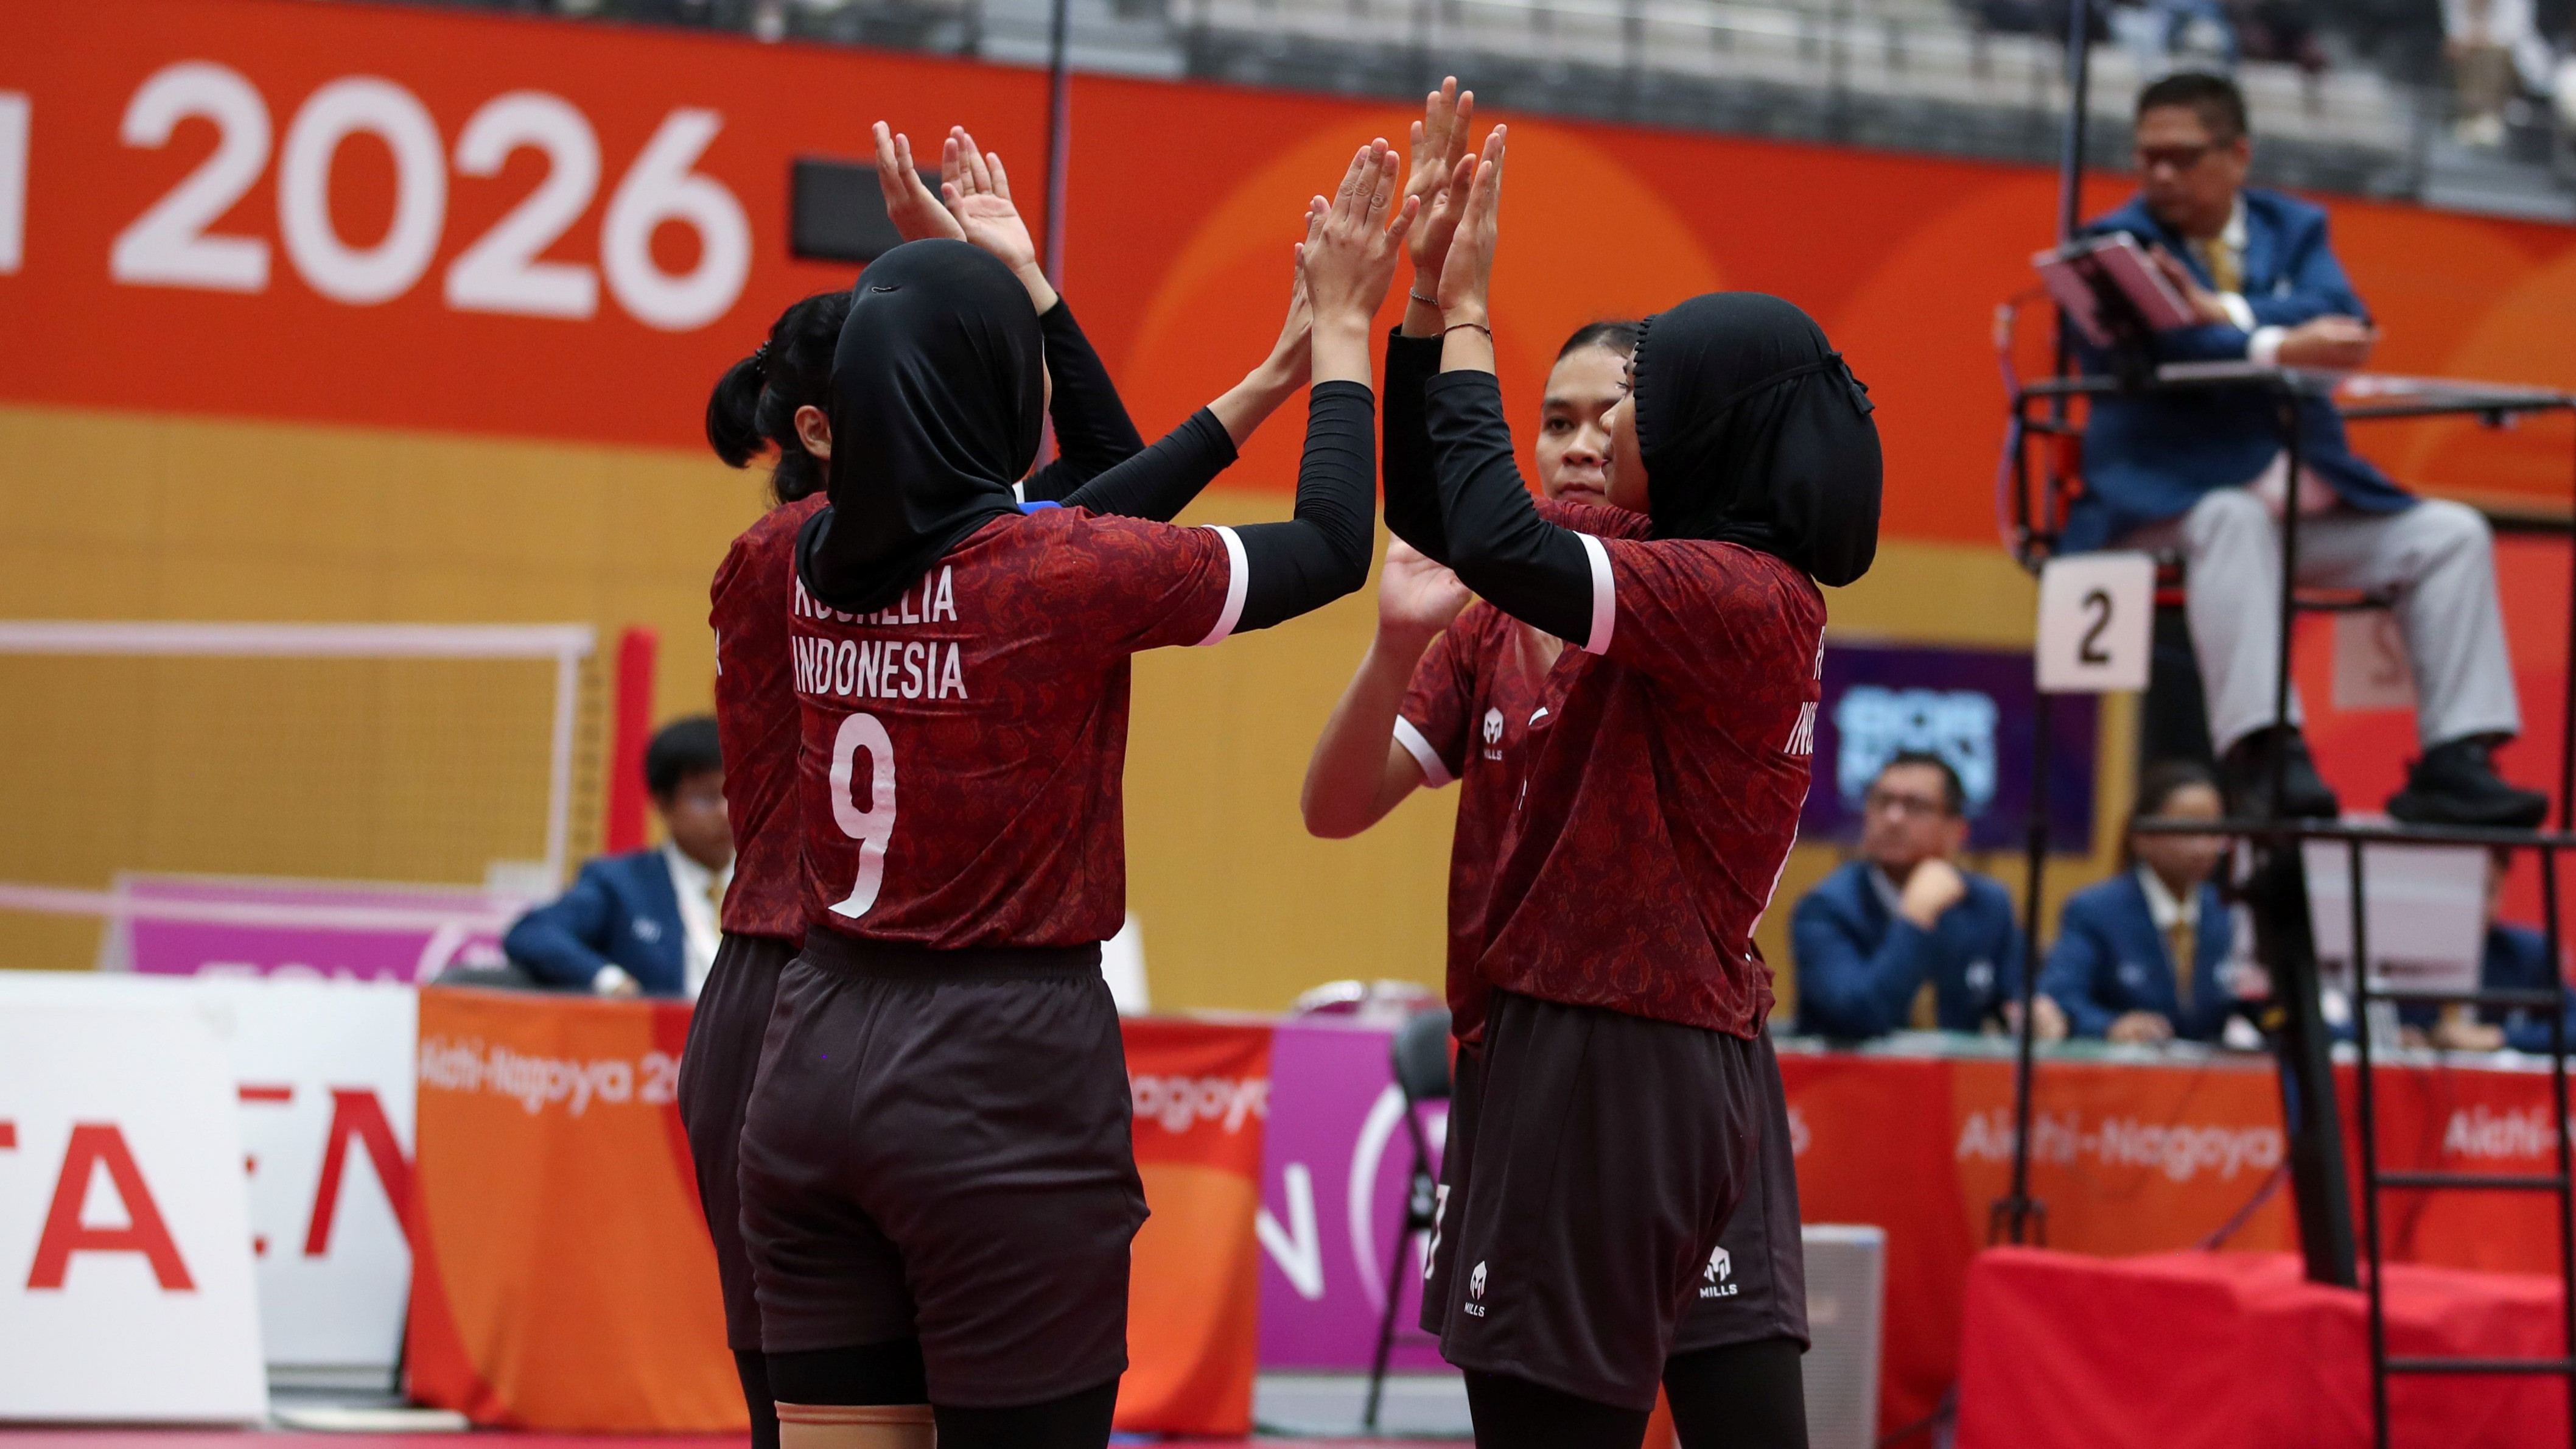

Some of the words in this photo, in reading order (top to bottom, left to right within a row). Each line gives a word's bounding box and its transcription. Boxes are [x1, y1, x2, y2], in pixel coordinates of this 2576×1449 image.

[111, 60, 752, 330] 2026
[795, 565, 957, 625] KLIA
[2077, 589, 2113, 665] 2
[792, 636, 968, 700] INDONESIA
[829, 712, 897, 919] 9
[0, 1120, 198, 1292] A
[1464, 1302, 1485, 1317] MILLS
[1700, 1283, 1738, 1298] MILLS
